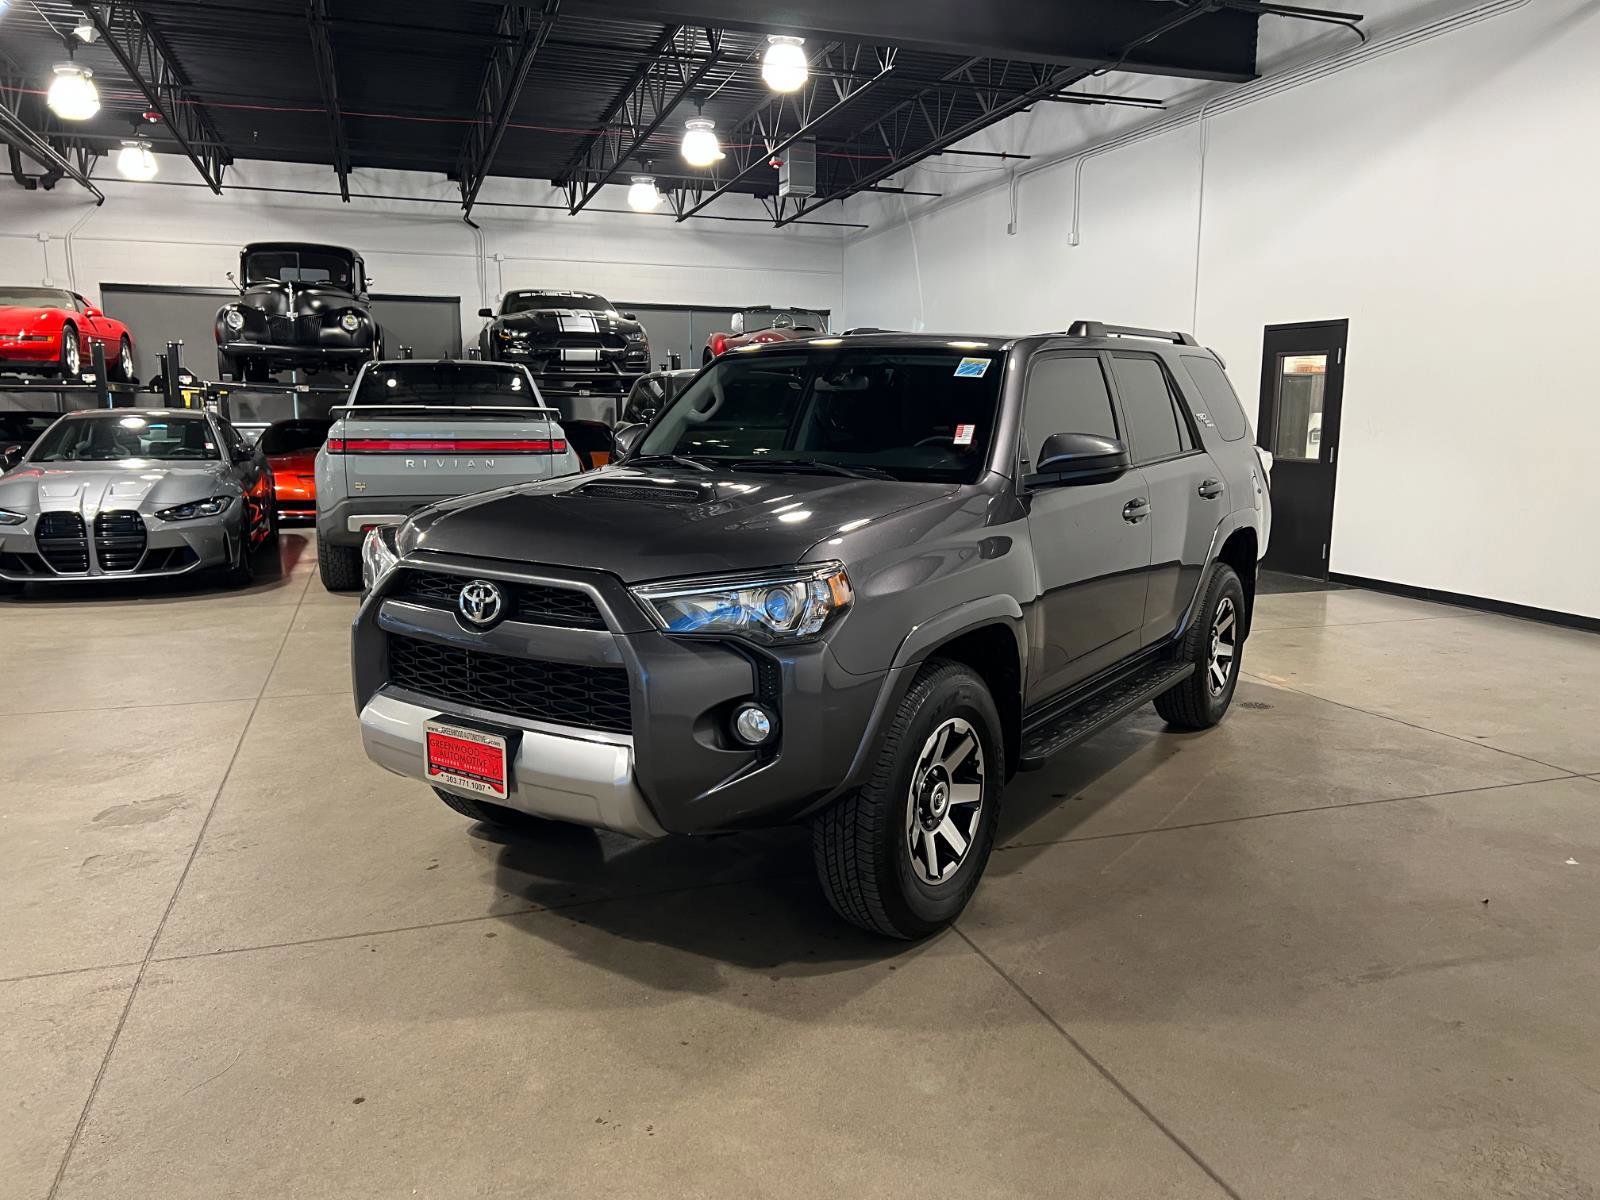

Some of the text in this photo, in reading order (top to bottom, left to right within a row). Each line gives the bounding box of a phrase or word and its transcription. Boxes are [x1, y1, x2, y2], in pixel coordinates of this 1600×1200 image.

[405, 459, 495, 468] RIVIAN
[429, 739, 480, 757] GREENWOOD
[438, 749, 488, 767] AUTOMOTIVE
